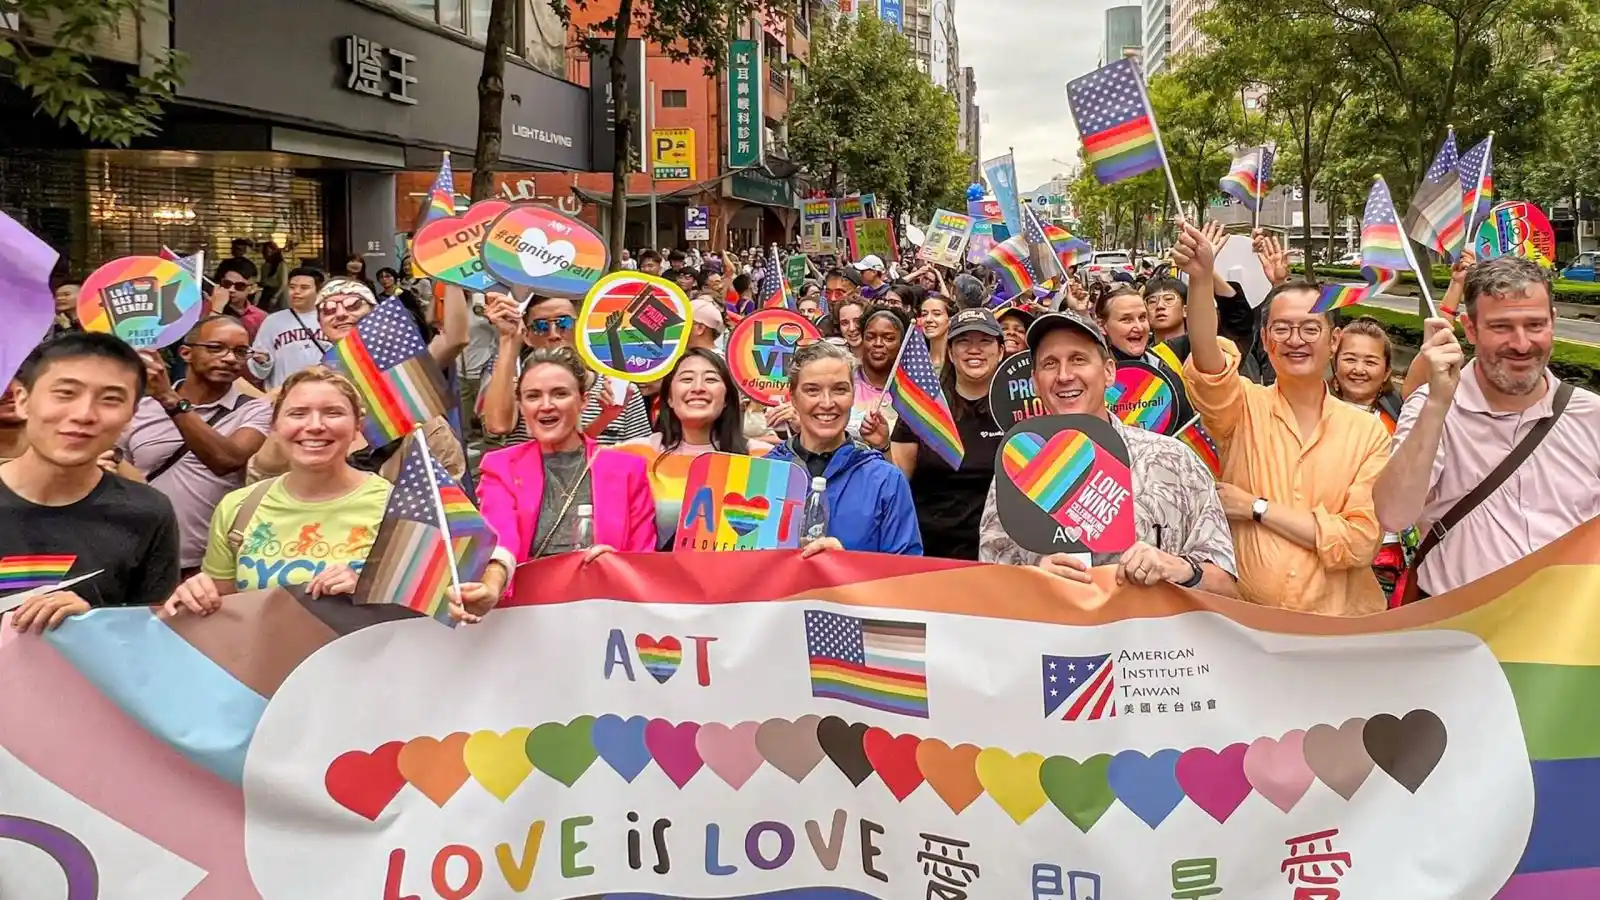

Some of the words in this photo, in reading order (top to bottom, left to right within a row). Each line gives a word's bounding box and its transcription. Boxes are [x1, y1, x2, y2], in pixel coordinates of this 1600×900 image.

[346, 34, 418, 105] 燈王
[511, 123, 573, 148] LIGHT&LIVING
[657, 138, 673, 160] P
[493, 229, 595, 280] #dignityforall
[459, 260, 485, 278] LO
[111, 296, 132, 307] HAS
[116, 303, 154, 314] GENDER
[1006, 364, 1017, 376] WE
[1017, 358, 1030, 368] ARE
[1008, 377, 1037, 401] PRO
[1012, 410, 1023, 422] TO
[1024, 397, 1053, 419] LO
[1089, 470, 1130, 509] LOVE
[1077, 486, 1118, 526] WINS
[681, 537, 764, 551] #LOVEIS
[237, 555, 366, 590] CYC
[1118, 648, 1195, 663] AMERICAN
[1122, 666, 1194, 680] INSTITUTE
[1197, 664, 1210, 676] IN
[1120, 684, 1180, 698] TAIWAN
[1124, 699, 1216, 715] 美國在台協會
[383, 815, 595, 900] LOVE
[705, 808, 889, 882] LOVE
